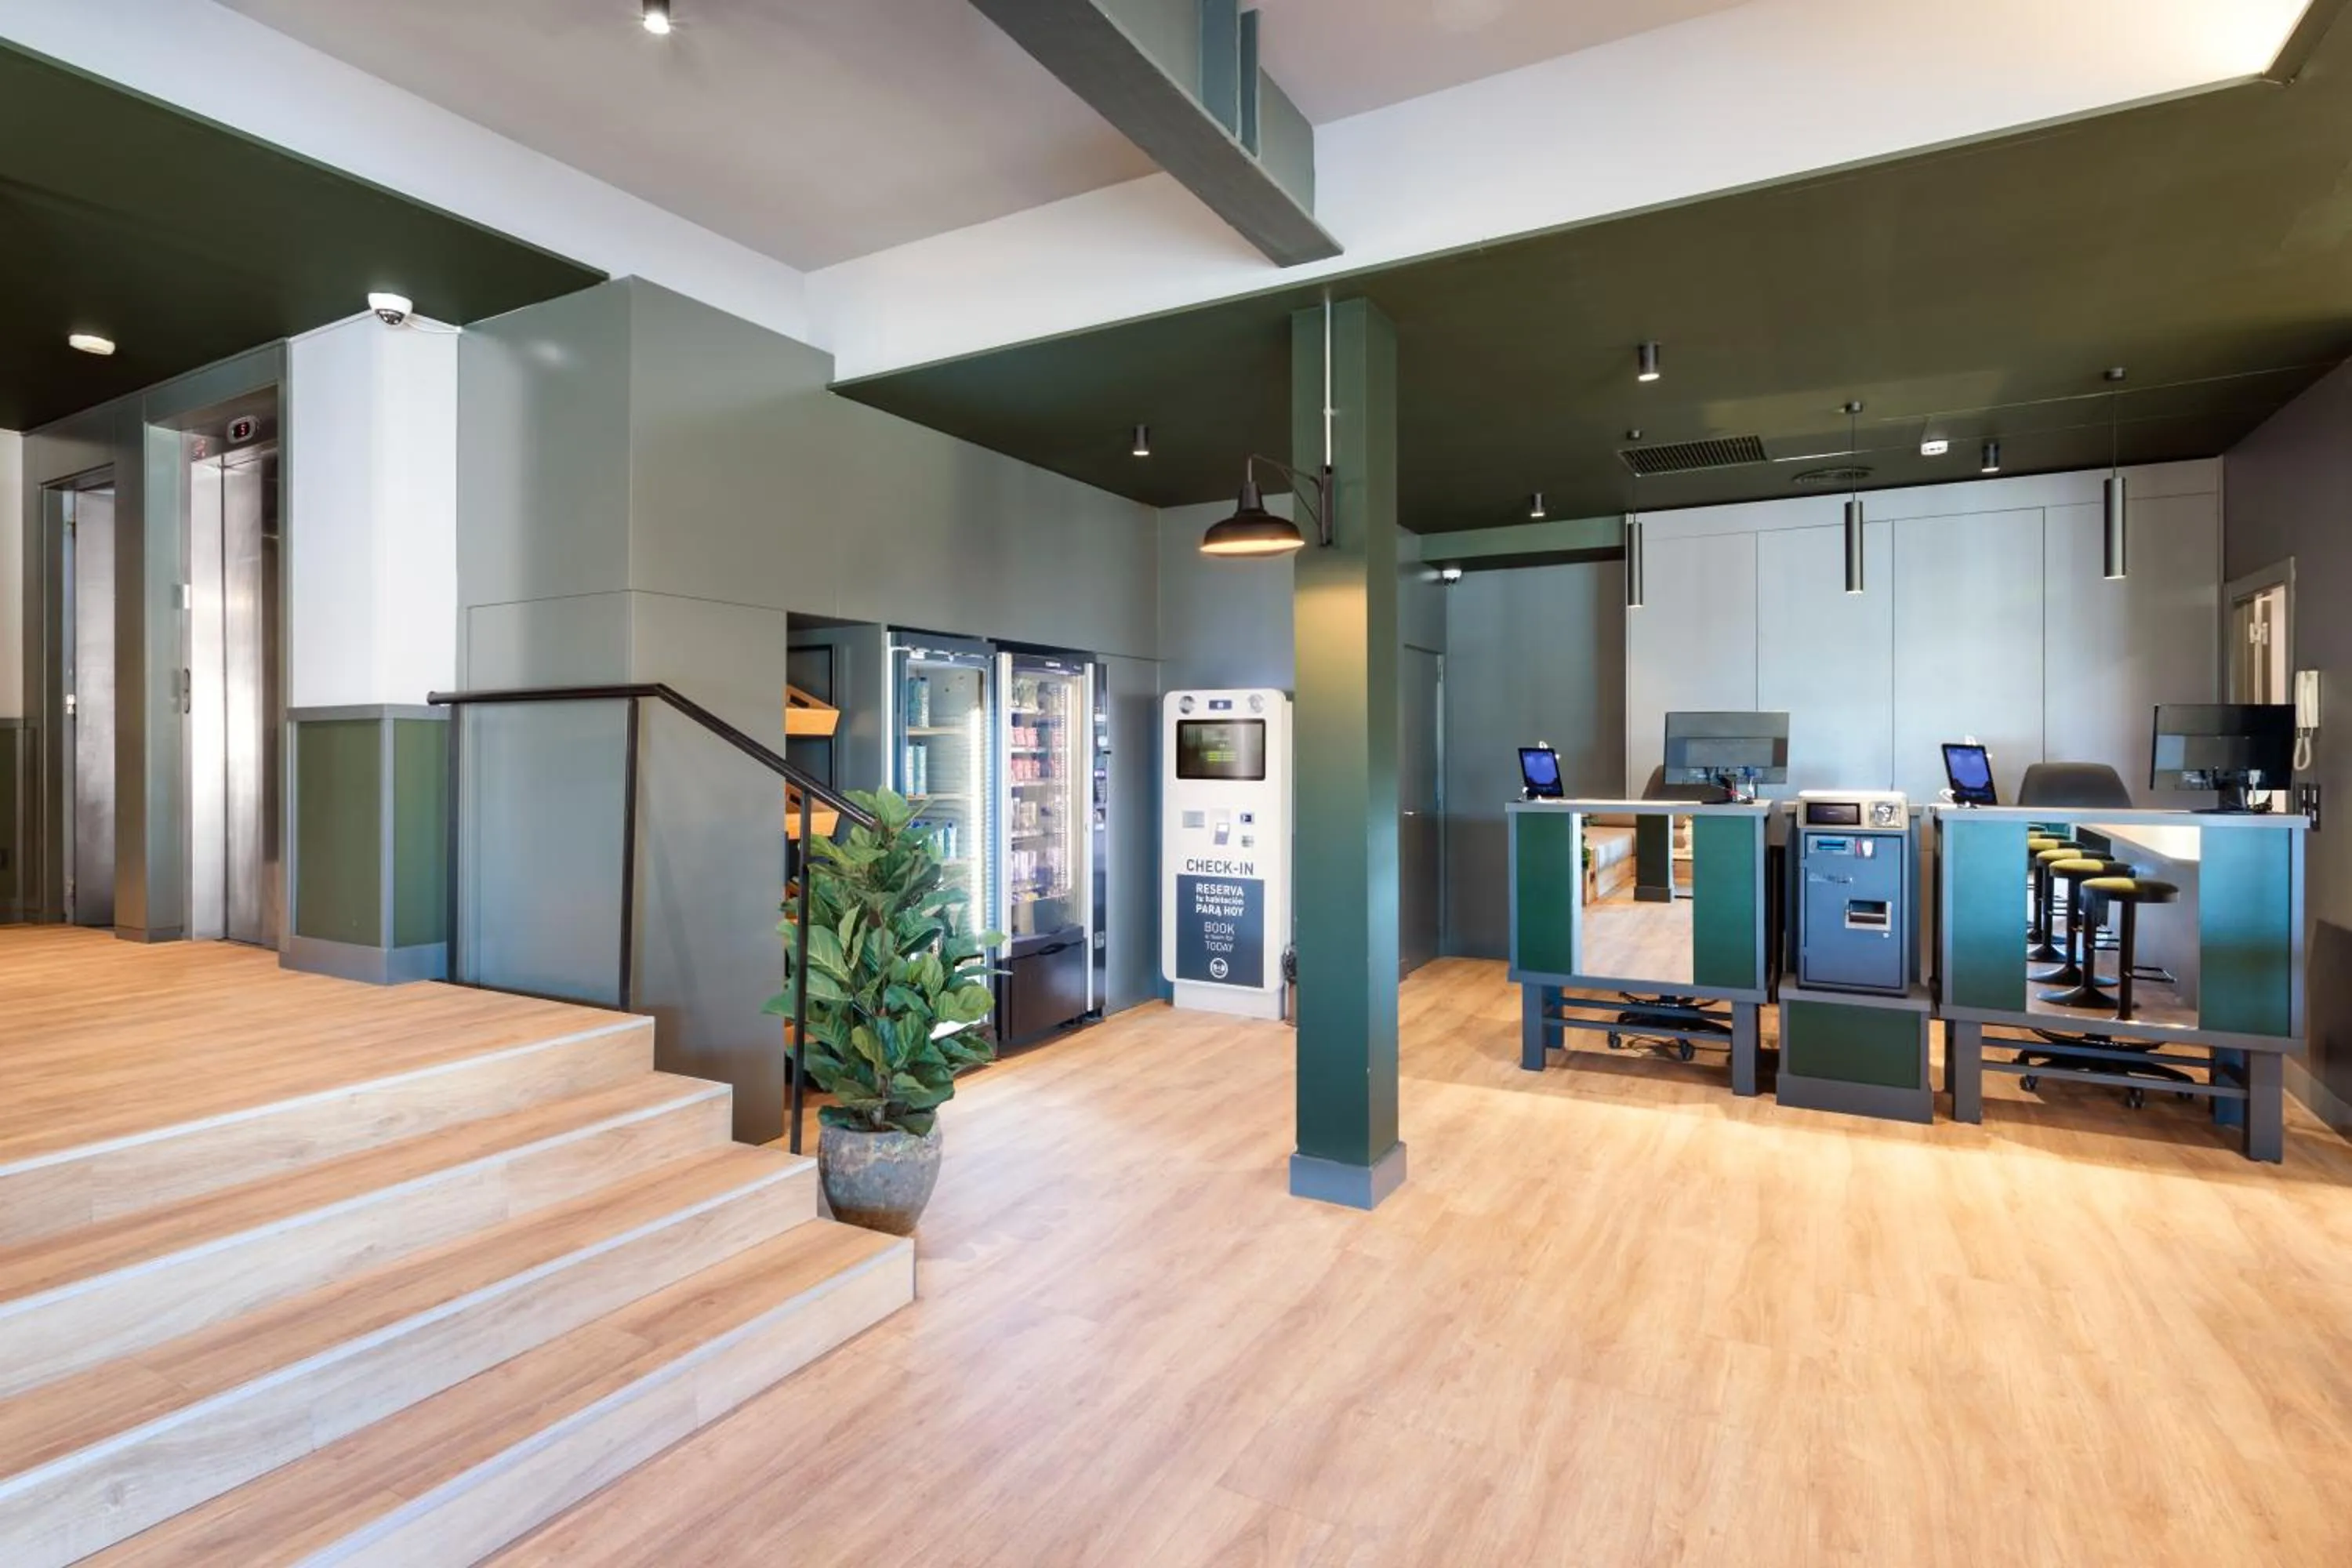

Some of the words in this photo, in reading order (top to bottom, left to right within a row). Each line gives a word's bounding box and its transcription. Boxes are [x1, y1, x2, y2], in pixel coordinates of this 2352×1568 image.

[1186, 858, 1254, 876] CHECK-IN
[1196, 883, 1244, 896] RESERVA
[1196, 903, 1221, 916] PARA
[1224, 906, 1244, 916] HOY
[1204, 921, 1235, 935] BOOK
[1205, 940, 1234, 953] TODAY
